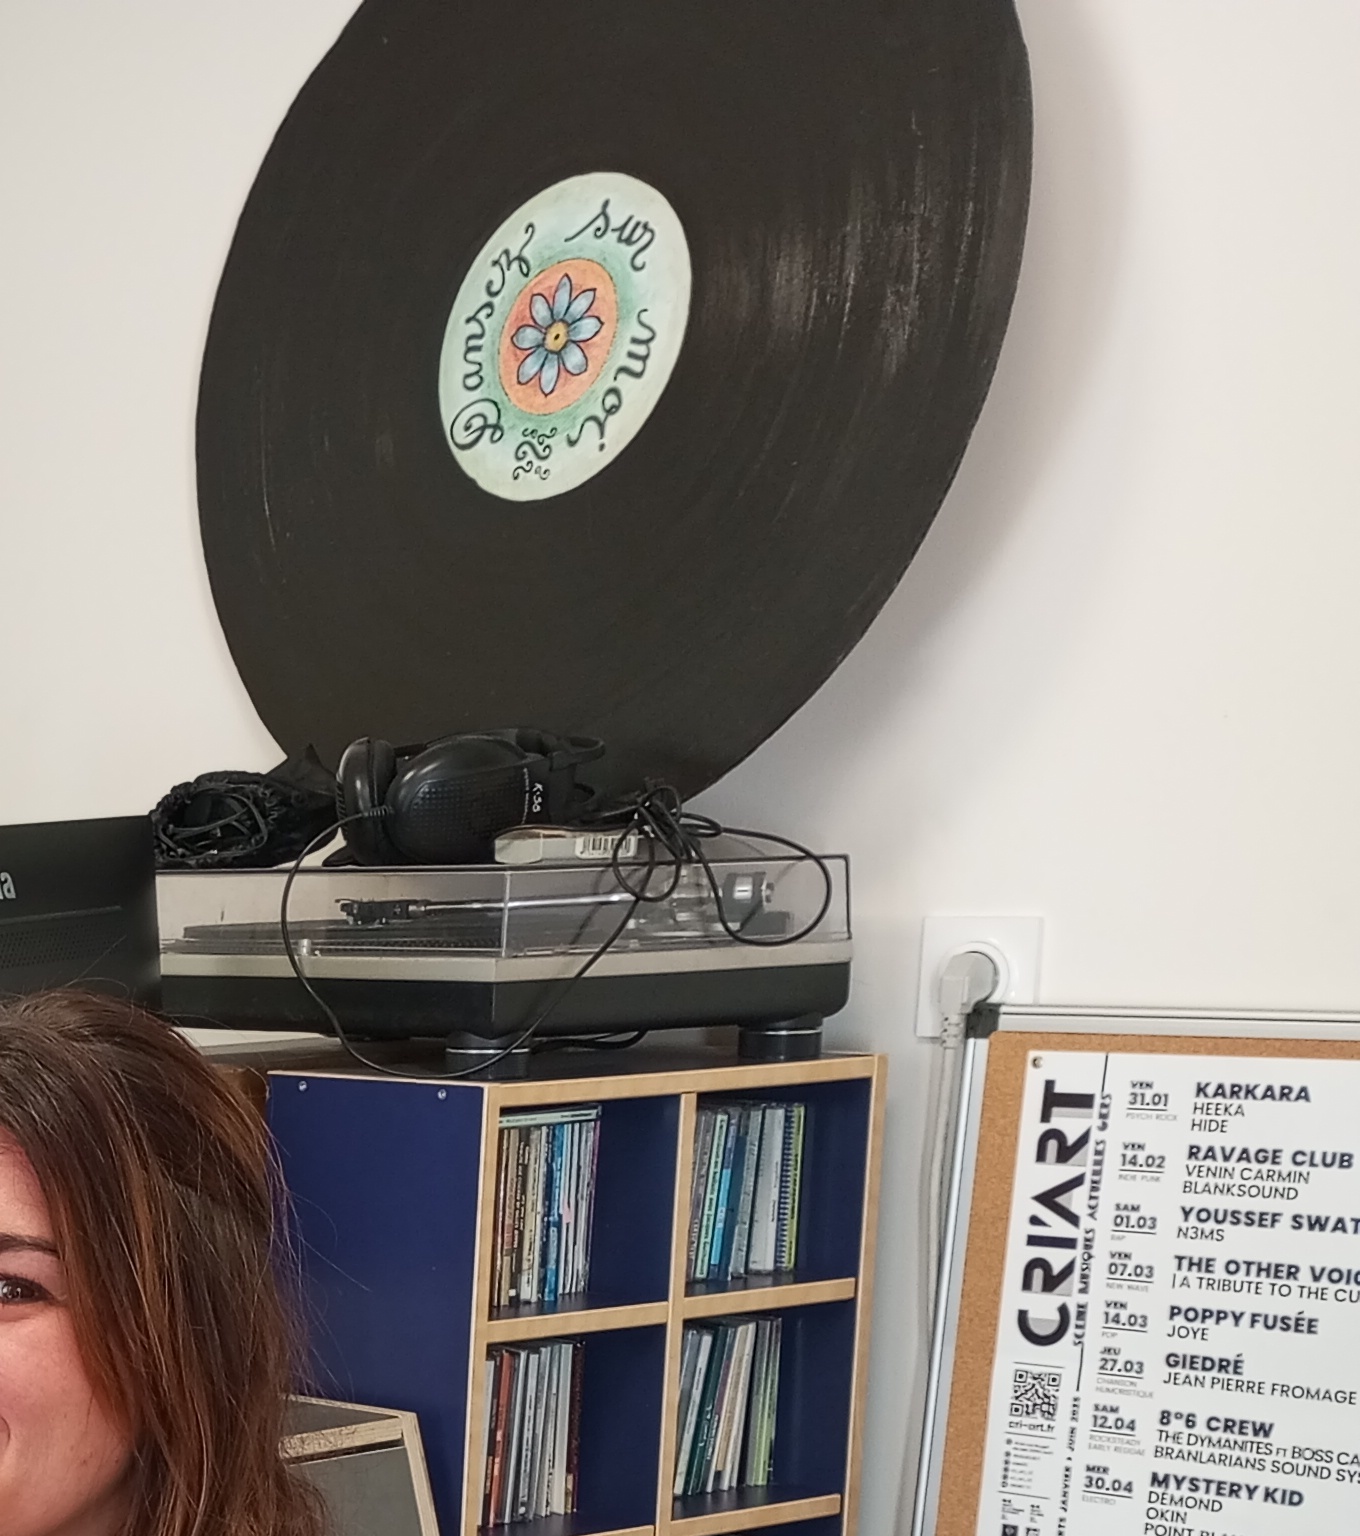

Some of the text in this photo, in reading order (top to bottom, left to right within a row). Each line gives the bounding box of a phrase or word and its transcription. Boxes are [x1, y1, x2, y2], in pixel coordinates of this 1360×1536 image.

[565, 198, 656, 272] sur
[567, 308, 657, 451] moi
[1128, 1092, 1169, 1107] 31.01
[1195, 1082, 1311, 1102] KARKARA
[1193, 1102, 1245, 1117] HEEKA
[1190, 1118, 1229, 1133] HIDE
[1120, 1154, 1166, 1169] 14.02
[1187, 1144, 1355, 1169] RAVAGE CLUB
[1185, 1164, 1310, 1184] VENIN CARMIN
[1182, 1181, 1299, 1200] BLANKSOUND
[1113, 1203, 1158, 1230] SAM 01.03
[1180, 1205, 1283, 1229] YOUSSEF
[1177, 1226, 1225, 1242] N3MS
[1108, 1263, 1154, 1279] 07.03
[1174, 1255, 1216, 1274] THE
[1224, 1259, 1300, 1282] OTHER
[1196, 1277, 1263, 1295] TRIBUTE
[1269, 1282, 1292, 1297] TO
[1297, 1285, 1329, 1301] THE
[1103, 1311, 1148, 1328] 14.03
[1169, 1305, 1319, 1335] POPPY FUSÉE
[1167, 1325, 1210, 1341] JOYE
[1099, 1357, 1145, 1374] 27.03
[1165, 1352, 1245, 1375] GIEDRÉ
[1163, 1372, 1357, 1405] JEAN PIERRE FROMAGE
[1092, 1414, 1136, 1432] 12.04
[1205, 1416, 1274, 1438] CREW
[1157, 1429, 1183, 1440] THE
[1186, 1433, 1273, 1456] DYMANITES
[1291, 1446, 1334, 1464] BOSS
[1154, 1445, 1266, 1471] BRANLARIANS
[1270, 1460, 1331, 1480] SOUND
[1084, 1475, 1133, 1493] 30.04
[1150, 1472, 1305, 1507] MYSTERY KID
[1147, 1491, 1223, 1513] DEMOND
[1146, 1507, 1187, 1525] OKIN
